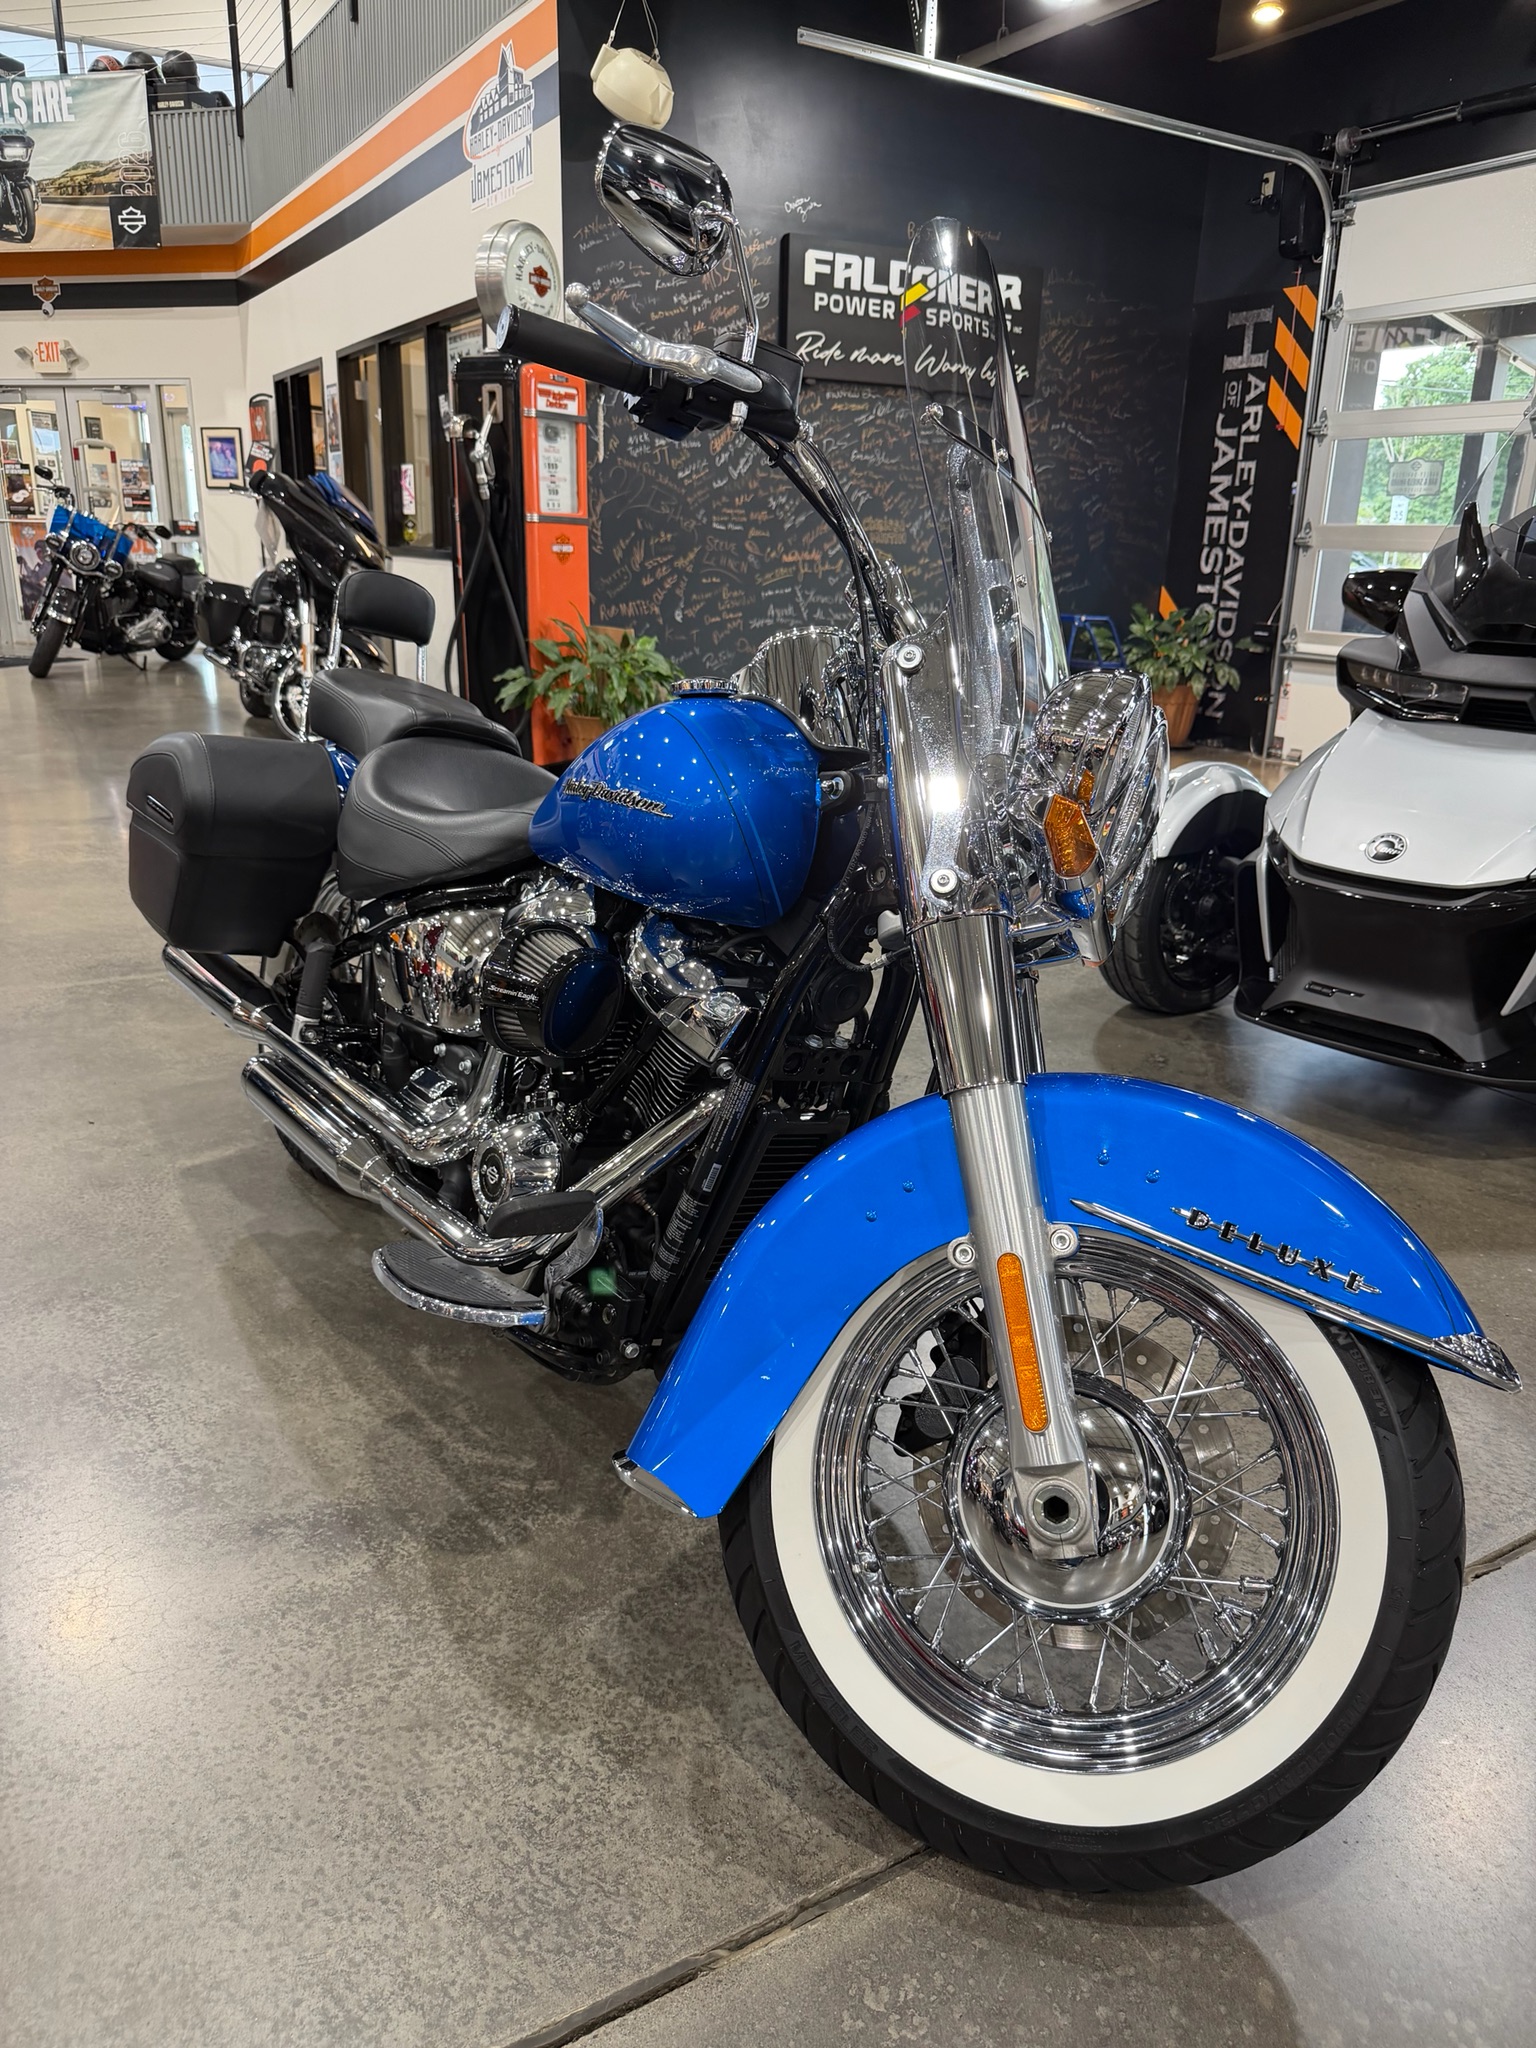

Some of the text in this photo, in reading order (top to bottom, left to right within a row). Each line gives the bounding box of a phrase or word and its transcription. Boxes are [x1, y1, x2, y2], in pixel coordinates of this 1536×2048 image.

[32, 80, 75, 124] ARE
[470, 102, 532, 158] HARLEY-DAVIDSON
[118, 130, 151, 195] 2026
[471, 133, 532, 203] JAMESTOWN
[803, 248, 1022, 317] FALCONER
[814, 292, 896, 320] POWER
[926, 308, 992, 339] SPORTS
[38, 341, 60, 362] EXIT
[795, 330, 845, 366] Ride
[850, 346, 904, 368] more
[914, 344, 978, 379] Worry
[1226, 380, 1240, 407] OF
[1191, 412, 1239, 645] JAMESTO
[1205, 304, 1275, 723] HARLEY-DAVIDSN
[562, 778, 673, 818] Harley-Davidson
[1186, 1206, 1365, 1294] DELUXE
[788, 1639, 880, 1760] METZELER
